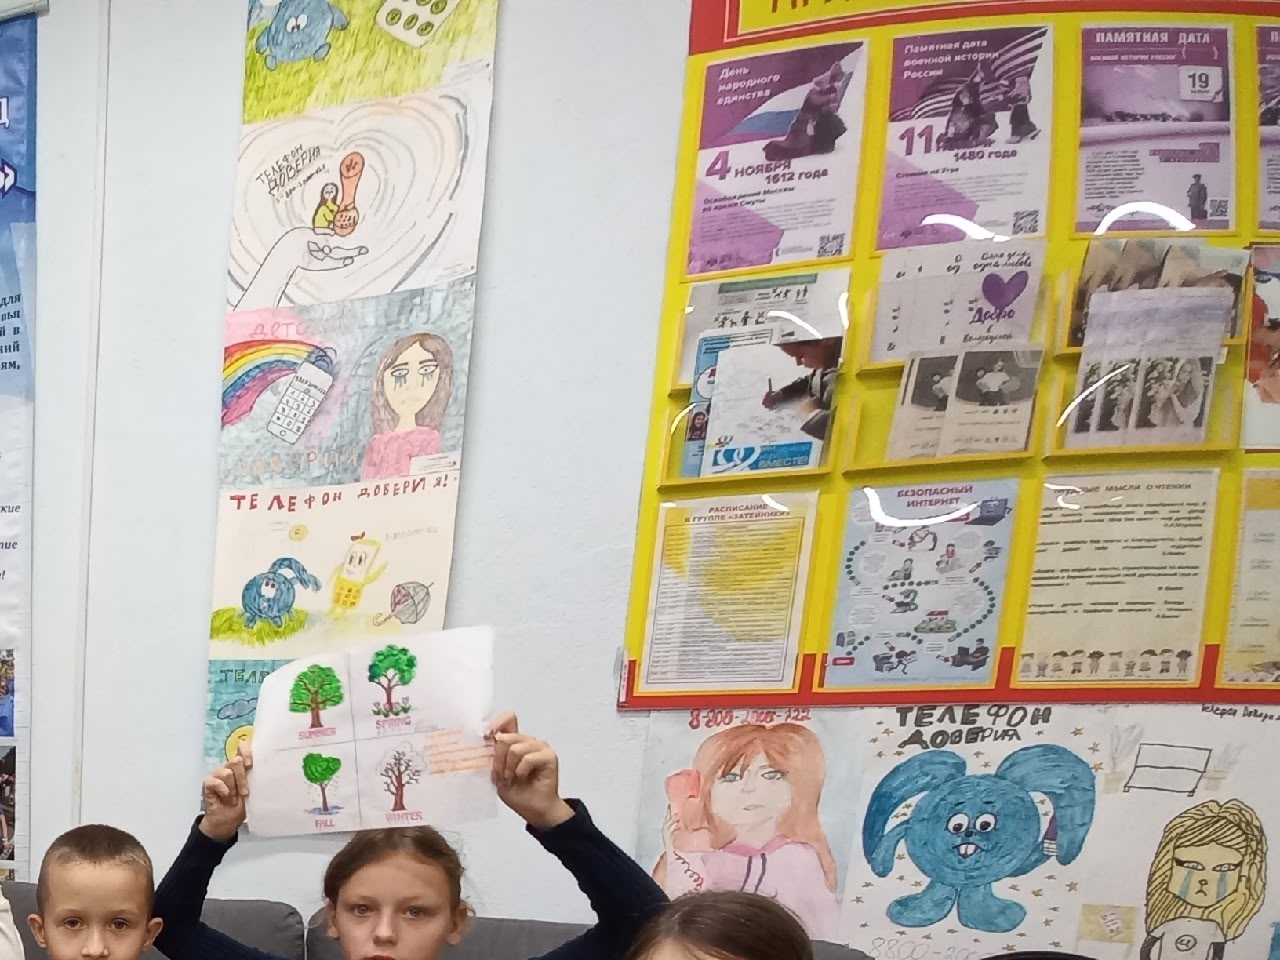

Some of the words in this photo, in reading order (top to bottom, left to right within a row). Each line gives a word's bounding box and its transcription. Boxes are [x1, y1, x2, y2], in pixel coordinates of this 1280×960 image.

[1095, 32, 1169, 43] ПАМЯТНАЯ
[1178, 32, 1210, 45] ДАТА
[904, 42, 959, 54] Памятная
[962, 40, 988, 51] дата
[904, 54, 952, 67] военной
[954, 52, 999, 62] истории
[720, 67, 750, 80] День
[903, 68, 944, 79] России
[1187, 72, 1210, 89] 19
[718, 74, 780, 92] народного
[716, 89, 771, 105] единства
[899, 124, 934, 156] 11
[705, 150, 731, 180] 4
[0, 293, 21, 308] для
[12, 325, 20, 335] в
[897, 485, 973, 497] БЕЗОПАСНЫЙ
[229, 492, 342, 512] ТЕЛЕФОН
[708, 503, 769, 513] РАСПИСАНИЕ
[906, 497, 961, 508] ИНТЕРНЕТ
[376, 716, 412, 730] SPRING
[895, 704, 1052, 727] ТЕЛЕФОН
[897, 726, 1022, 749] ДОВЕРИЯ
